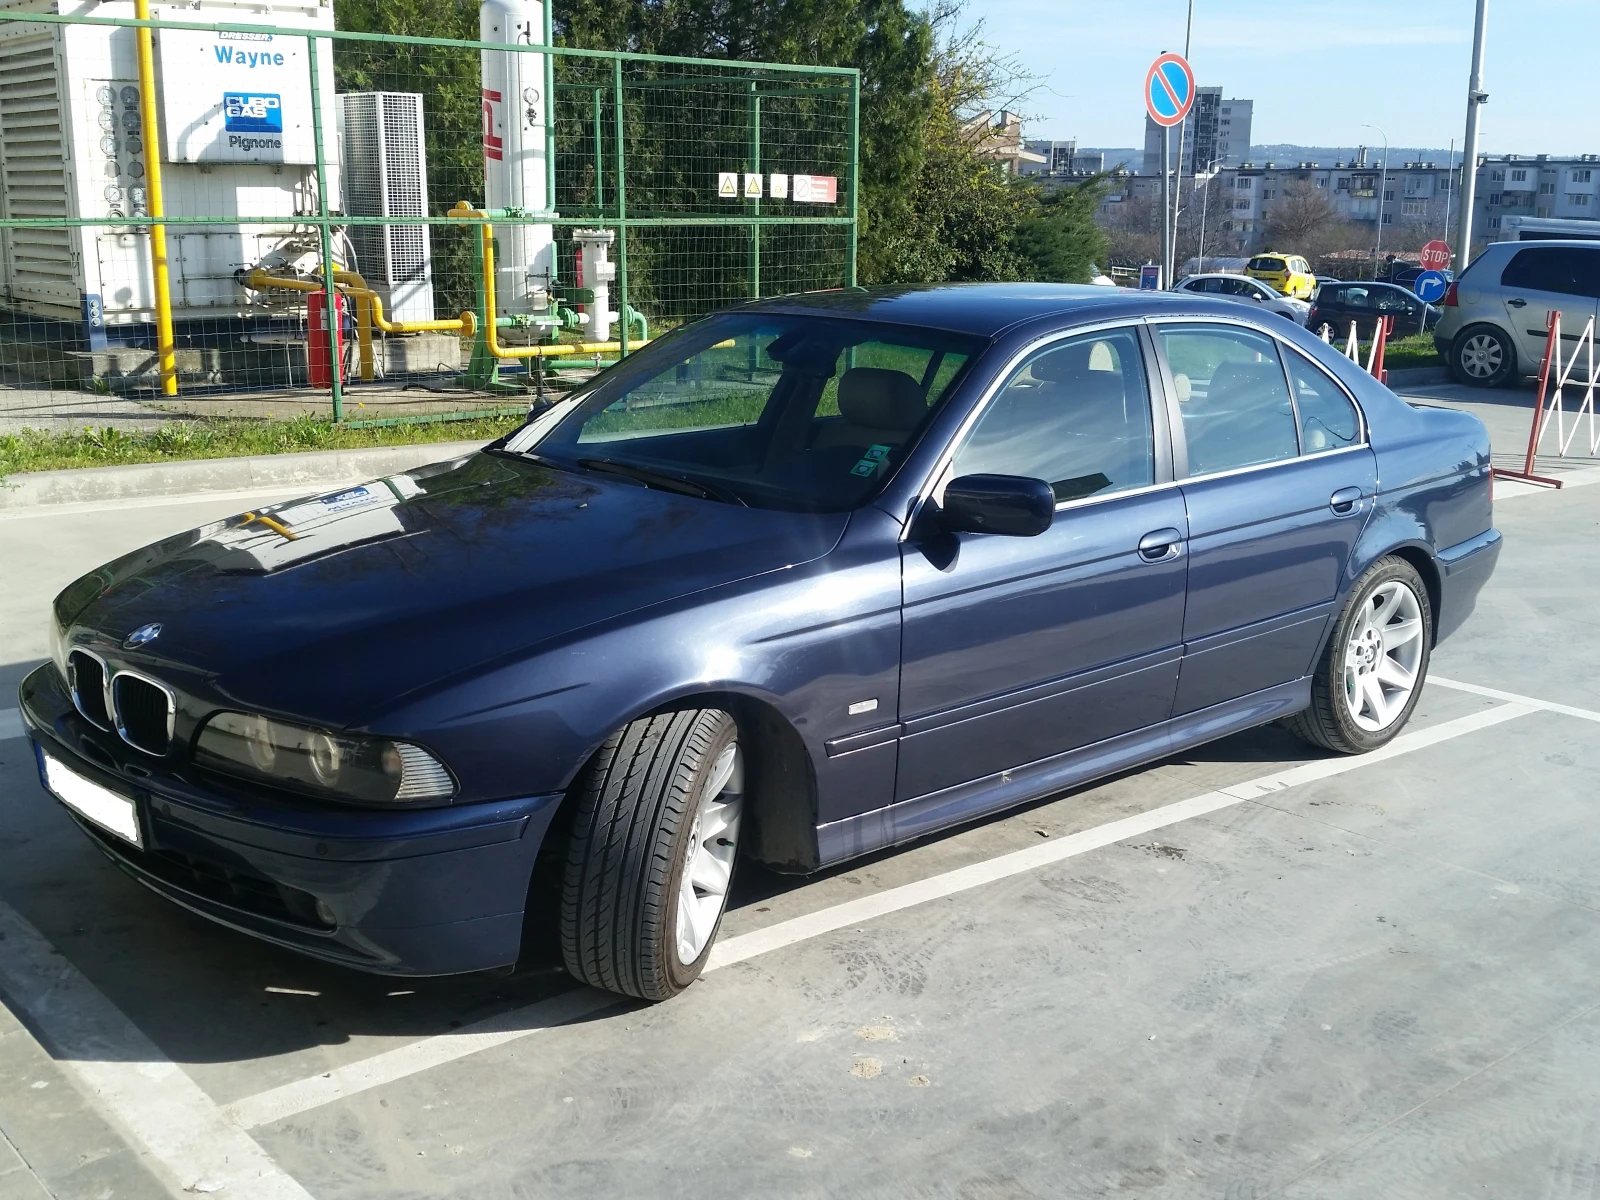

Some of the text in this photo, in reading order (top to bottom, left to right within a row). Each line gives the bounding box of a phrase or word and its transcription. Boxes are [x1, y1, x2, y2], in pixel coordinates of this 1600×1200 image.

[219, 31, 269, 41] DRESSER
[214, 45, 284, 68] Wayne
[226, 96, 279, 108] CUBO
[226, 106, 267, 118] GAS
[229, 135, 281, 151] Pignone
[1422, 249, 1448, 263] STOP
